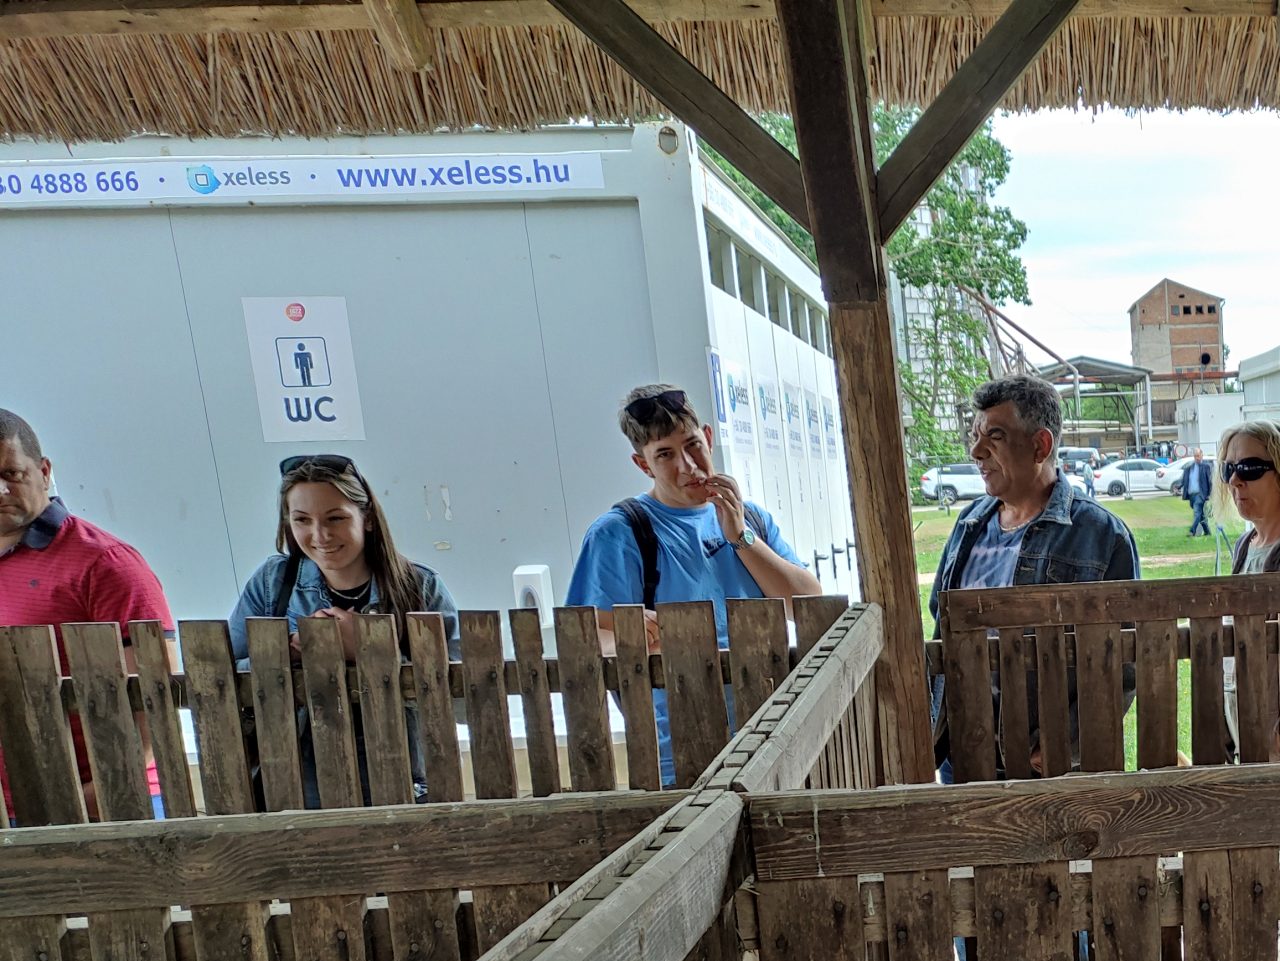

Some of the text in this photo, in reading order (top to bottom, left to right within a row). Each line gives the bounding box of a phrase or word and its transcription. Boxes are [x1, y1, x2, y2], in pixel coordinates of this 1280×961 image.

[30, 172, 88, 195] 4888
[96, 170, 139, 193] 666
[222, 166, 291, 186] xeless
[337, 159, 570, 187] www.xeless.hu
[283, 396, 337, 422] WC
